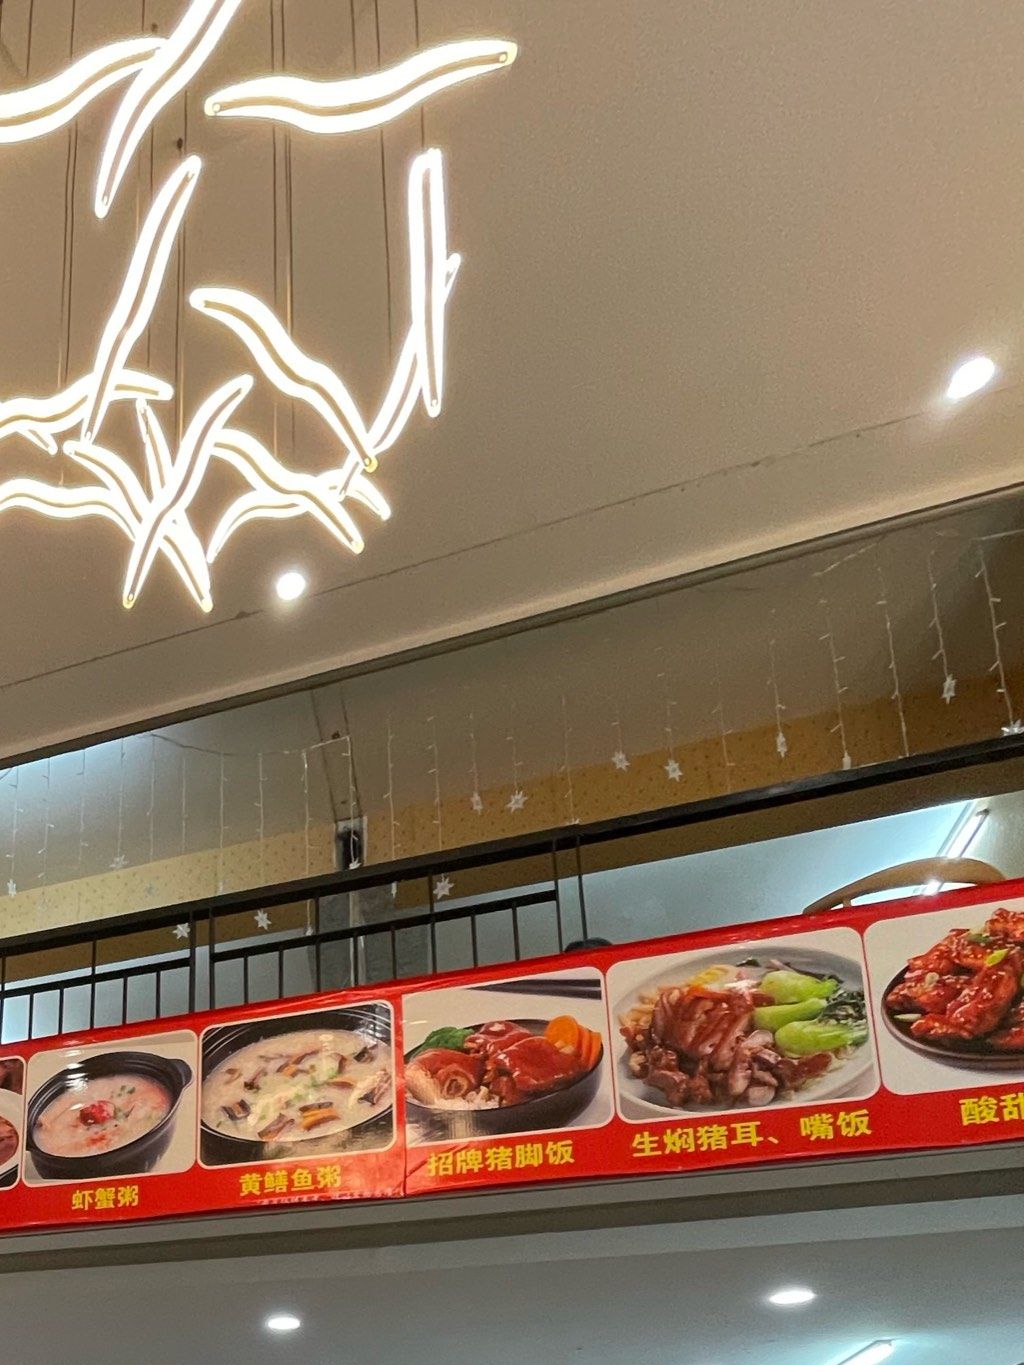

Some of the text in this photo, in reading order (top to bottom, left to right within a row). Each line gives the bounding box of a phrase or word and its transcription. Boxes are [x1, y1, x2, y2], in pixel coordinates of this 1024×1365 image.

[632, 1109, 873, 1157] 生焖猪耳、嘴饭
[427, 1139, 575, 1177] 招牌猪脚饭
[71, 1185, 139, 1211] 虾蟹粥
[239, 1165, 342, 1197] 黄鳝鱼粥
